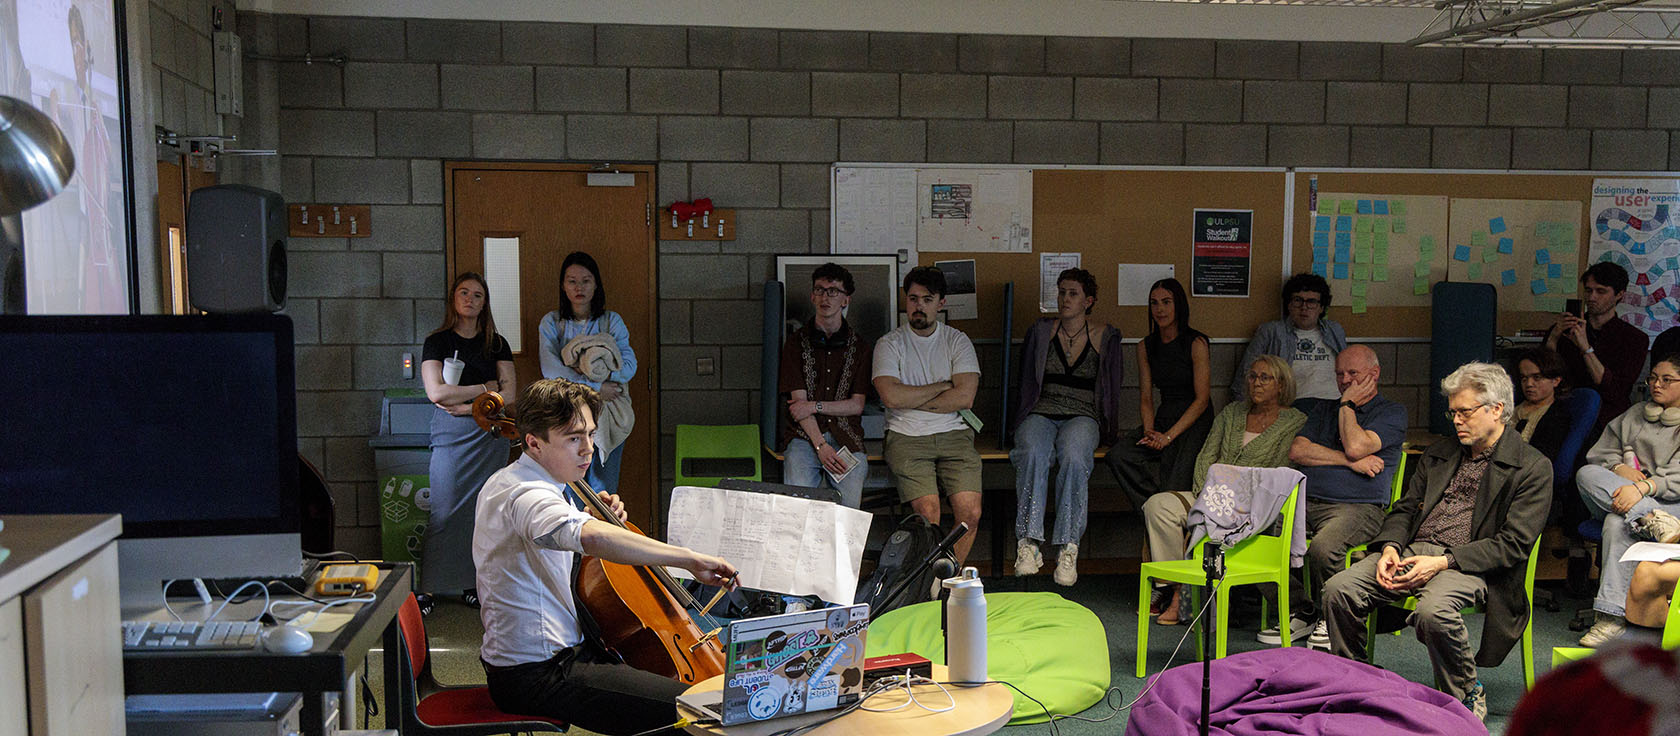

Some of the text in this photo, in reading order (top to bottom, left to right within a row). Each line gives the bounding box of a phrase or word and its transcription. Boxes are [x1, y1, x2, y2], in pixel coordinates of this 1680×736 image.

[1594, 185, 1635, 196] designing
[1615, 195, 1651, 207] user
[810, 643, 847, 685] Hardware
